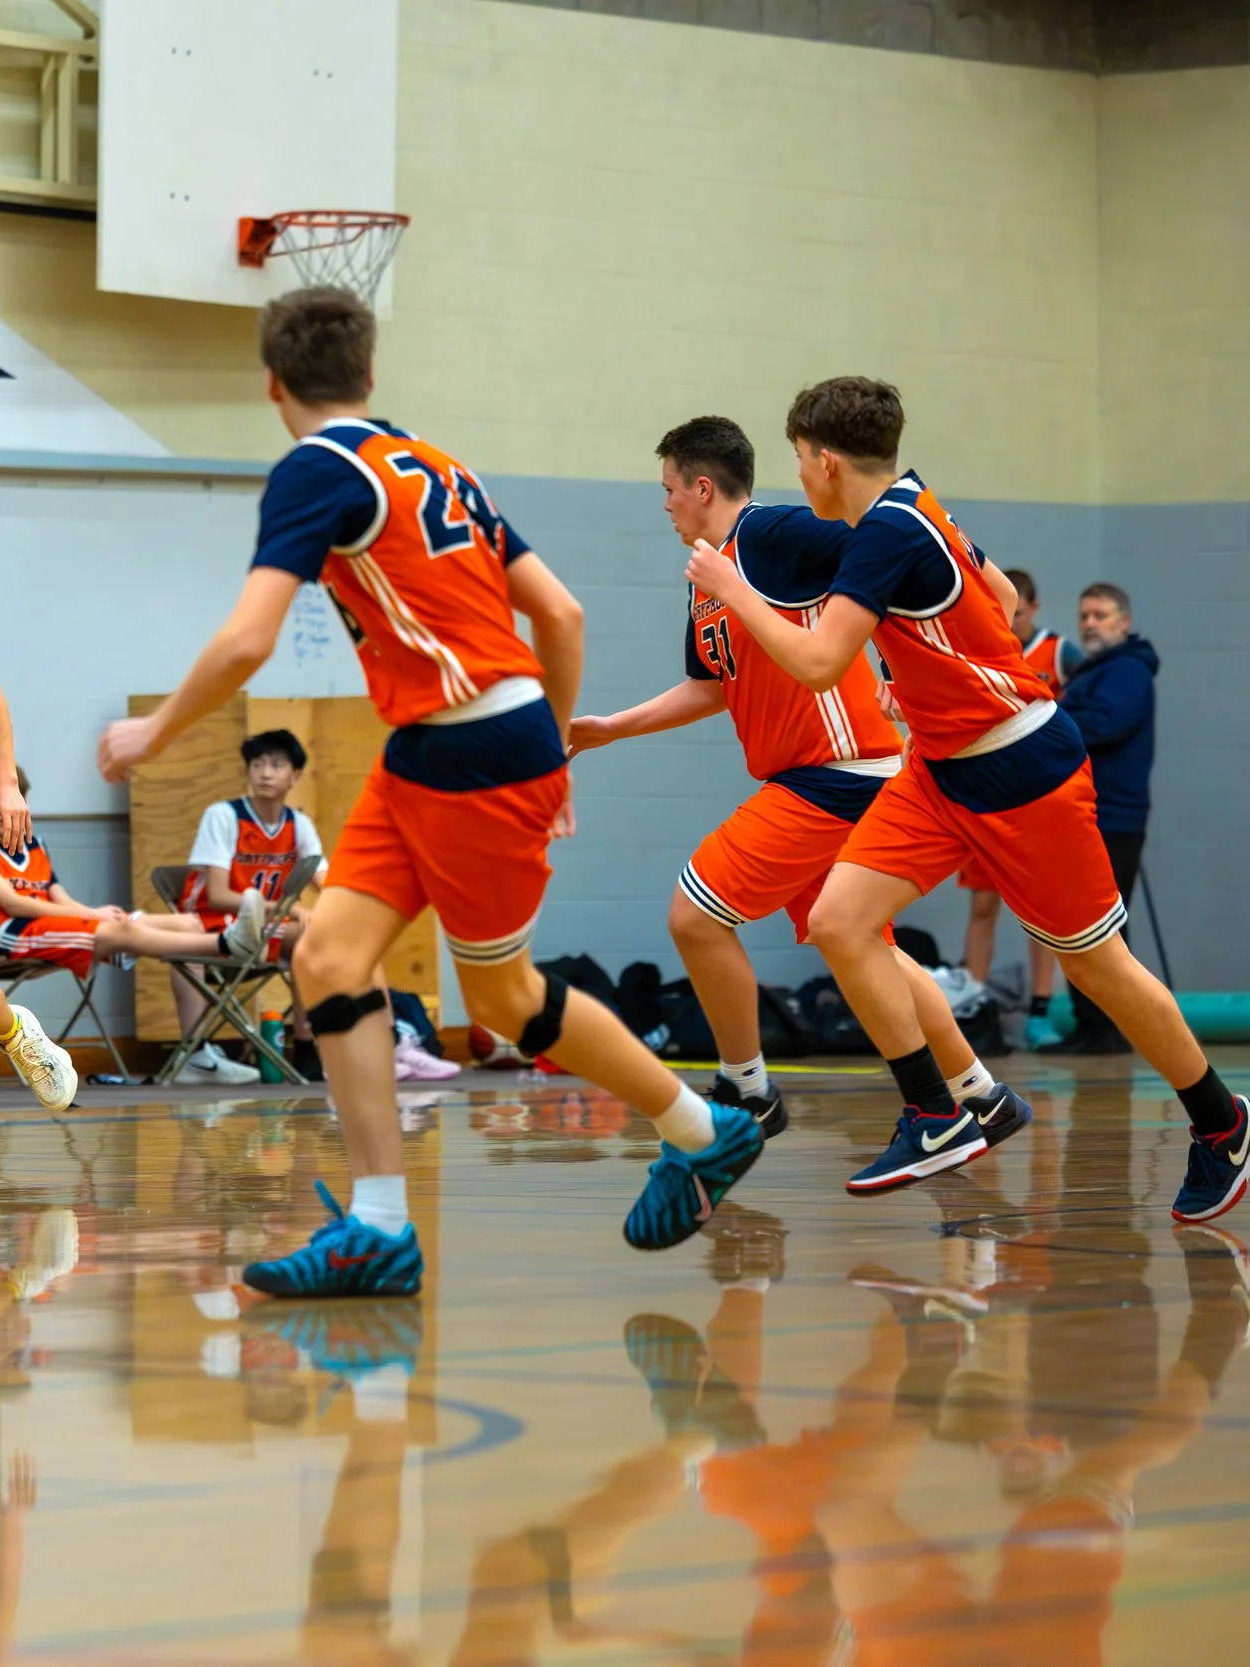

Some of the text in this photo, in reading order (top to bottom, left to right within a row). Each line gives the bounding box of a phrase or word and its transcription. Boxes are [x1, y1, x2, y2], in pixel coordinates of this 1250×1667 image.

[384, 449, 500, 560] 24
[701, 615, 737, 685] 31
[252, 869, 282, 900] 11
